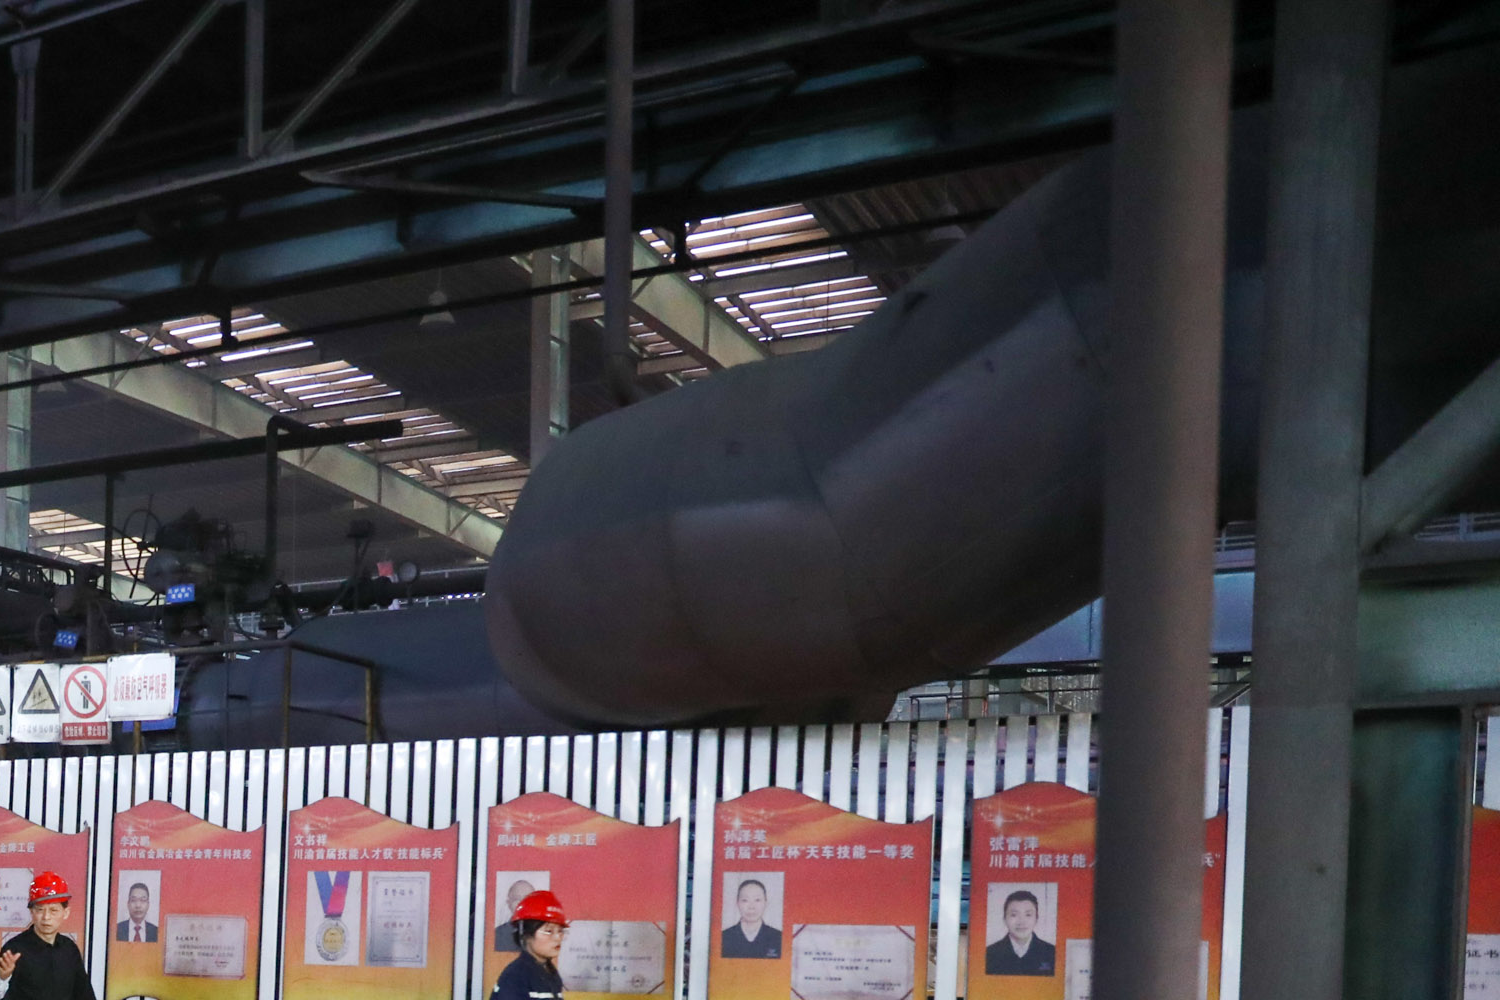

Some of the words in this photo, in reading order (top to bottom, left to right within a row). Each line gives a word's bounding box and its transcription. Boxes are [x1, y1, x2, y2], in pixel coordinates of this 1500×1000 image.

[294, 834, 328, 846] 文书祥
[545, 833, 597, 846] 金牌工匠
[724, 829, 767, 843] 孙泽英
[989, 836, 1040, 851] 张雷萍
[119, 849, 252, 860] 四川省金属冶金学会青年科技奖
[989, 853, 1095, 869] 川渝首届技能
